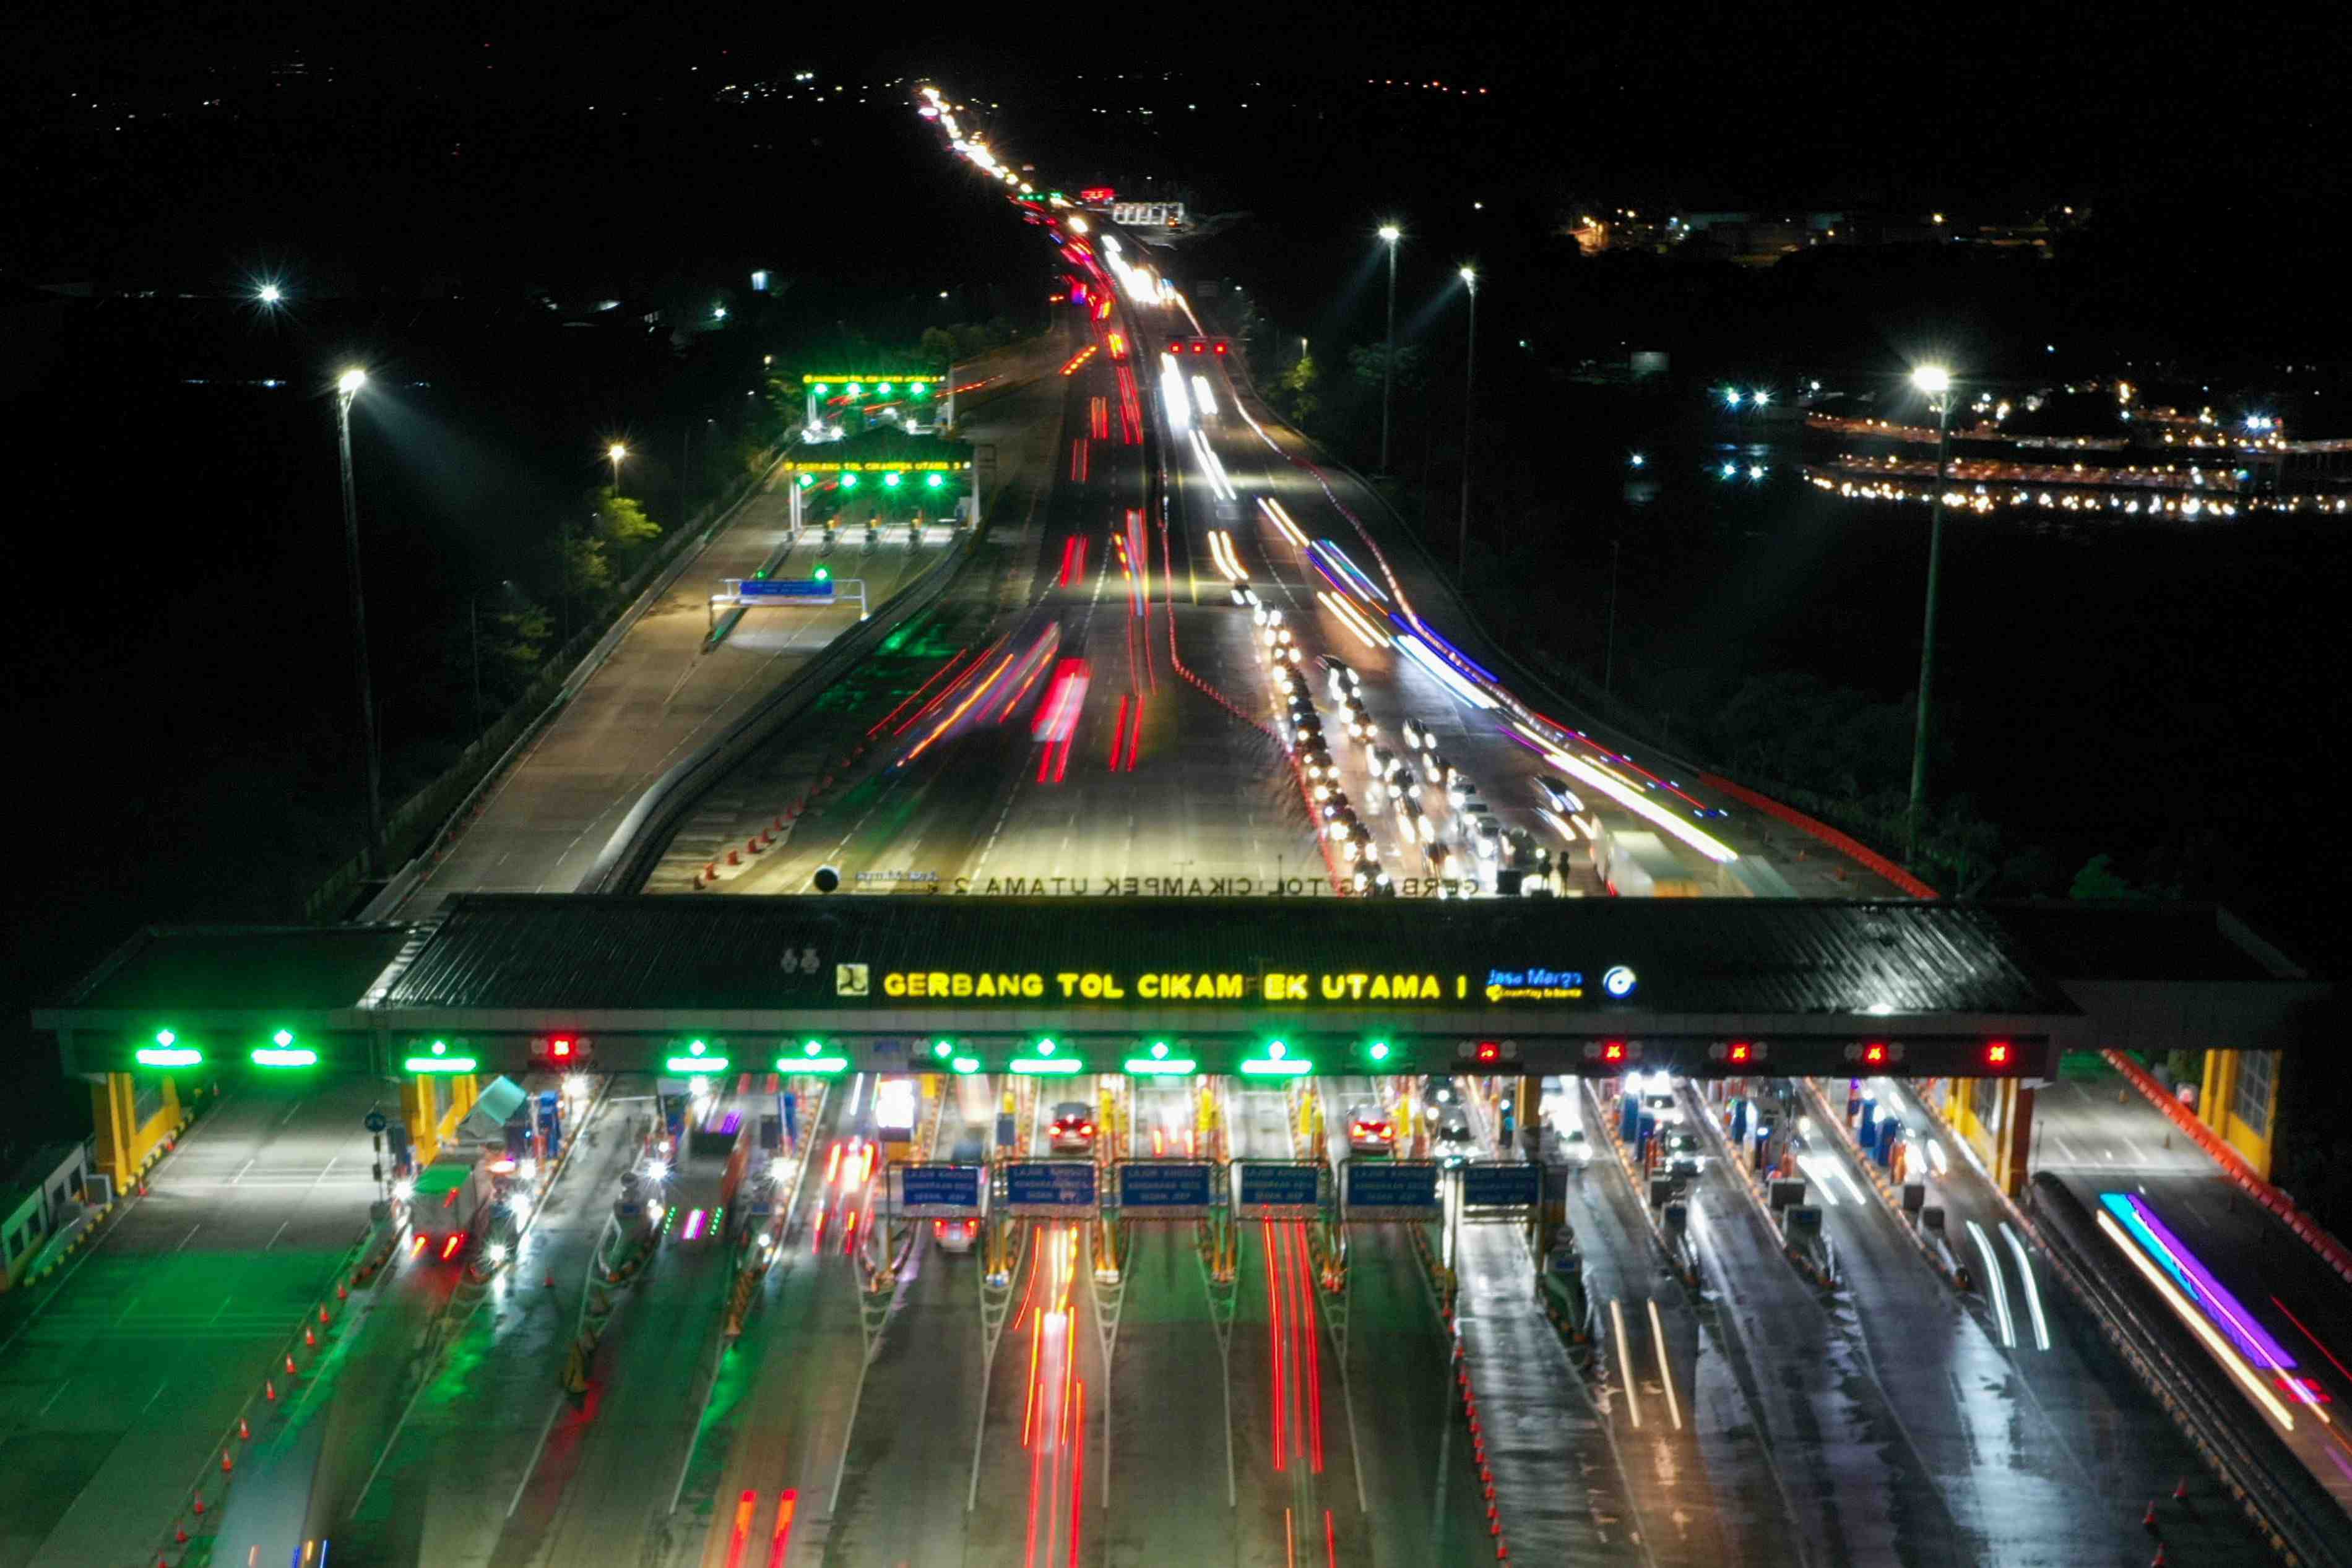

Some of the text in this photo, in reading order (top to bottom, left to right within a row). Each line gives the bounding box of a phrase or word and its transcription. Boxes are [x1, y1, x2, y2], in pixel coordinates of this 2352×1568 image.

[884, 972, 1044, 997] GERBANG
[1057, 972, 1124, 998] TOL
[1321, 973, 1440, 999] UTAMA
